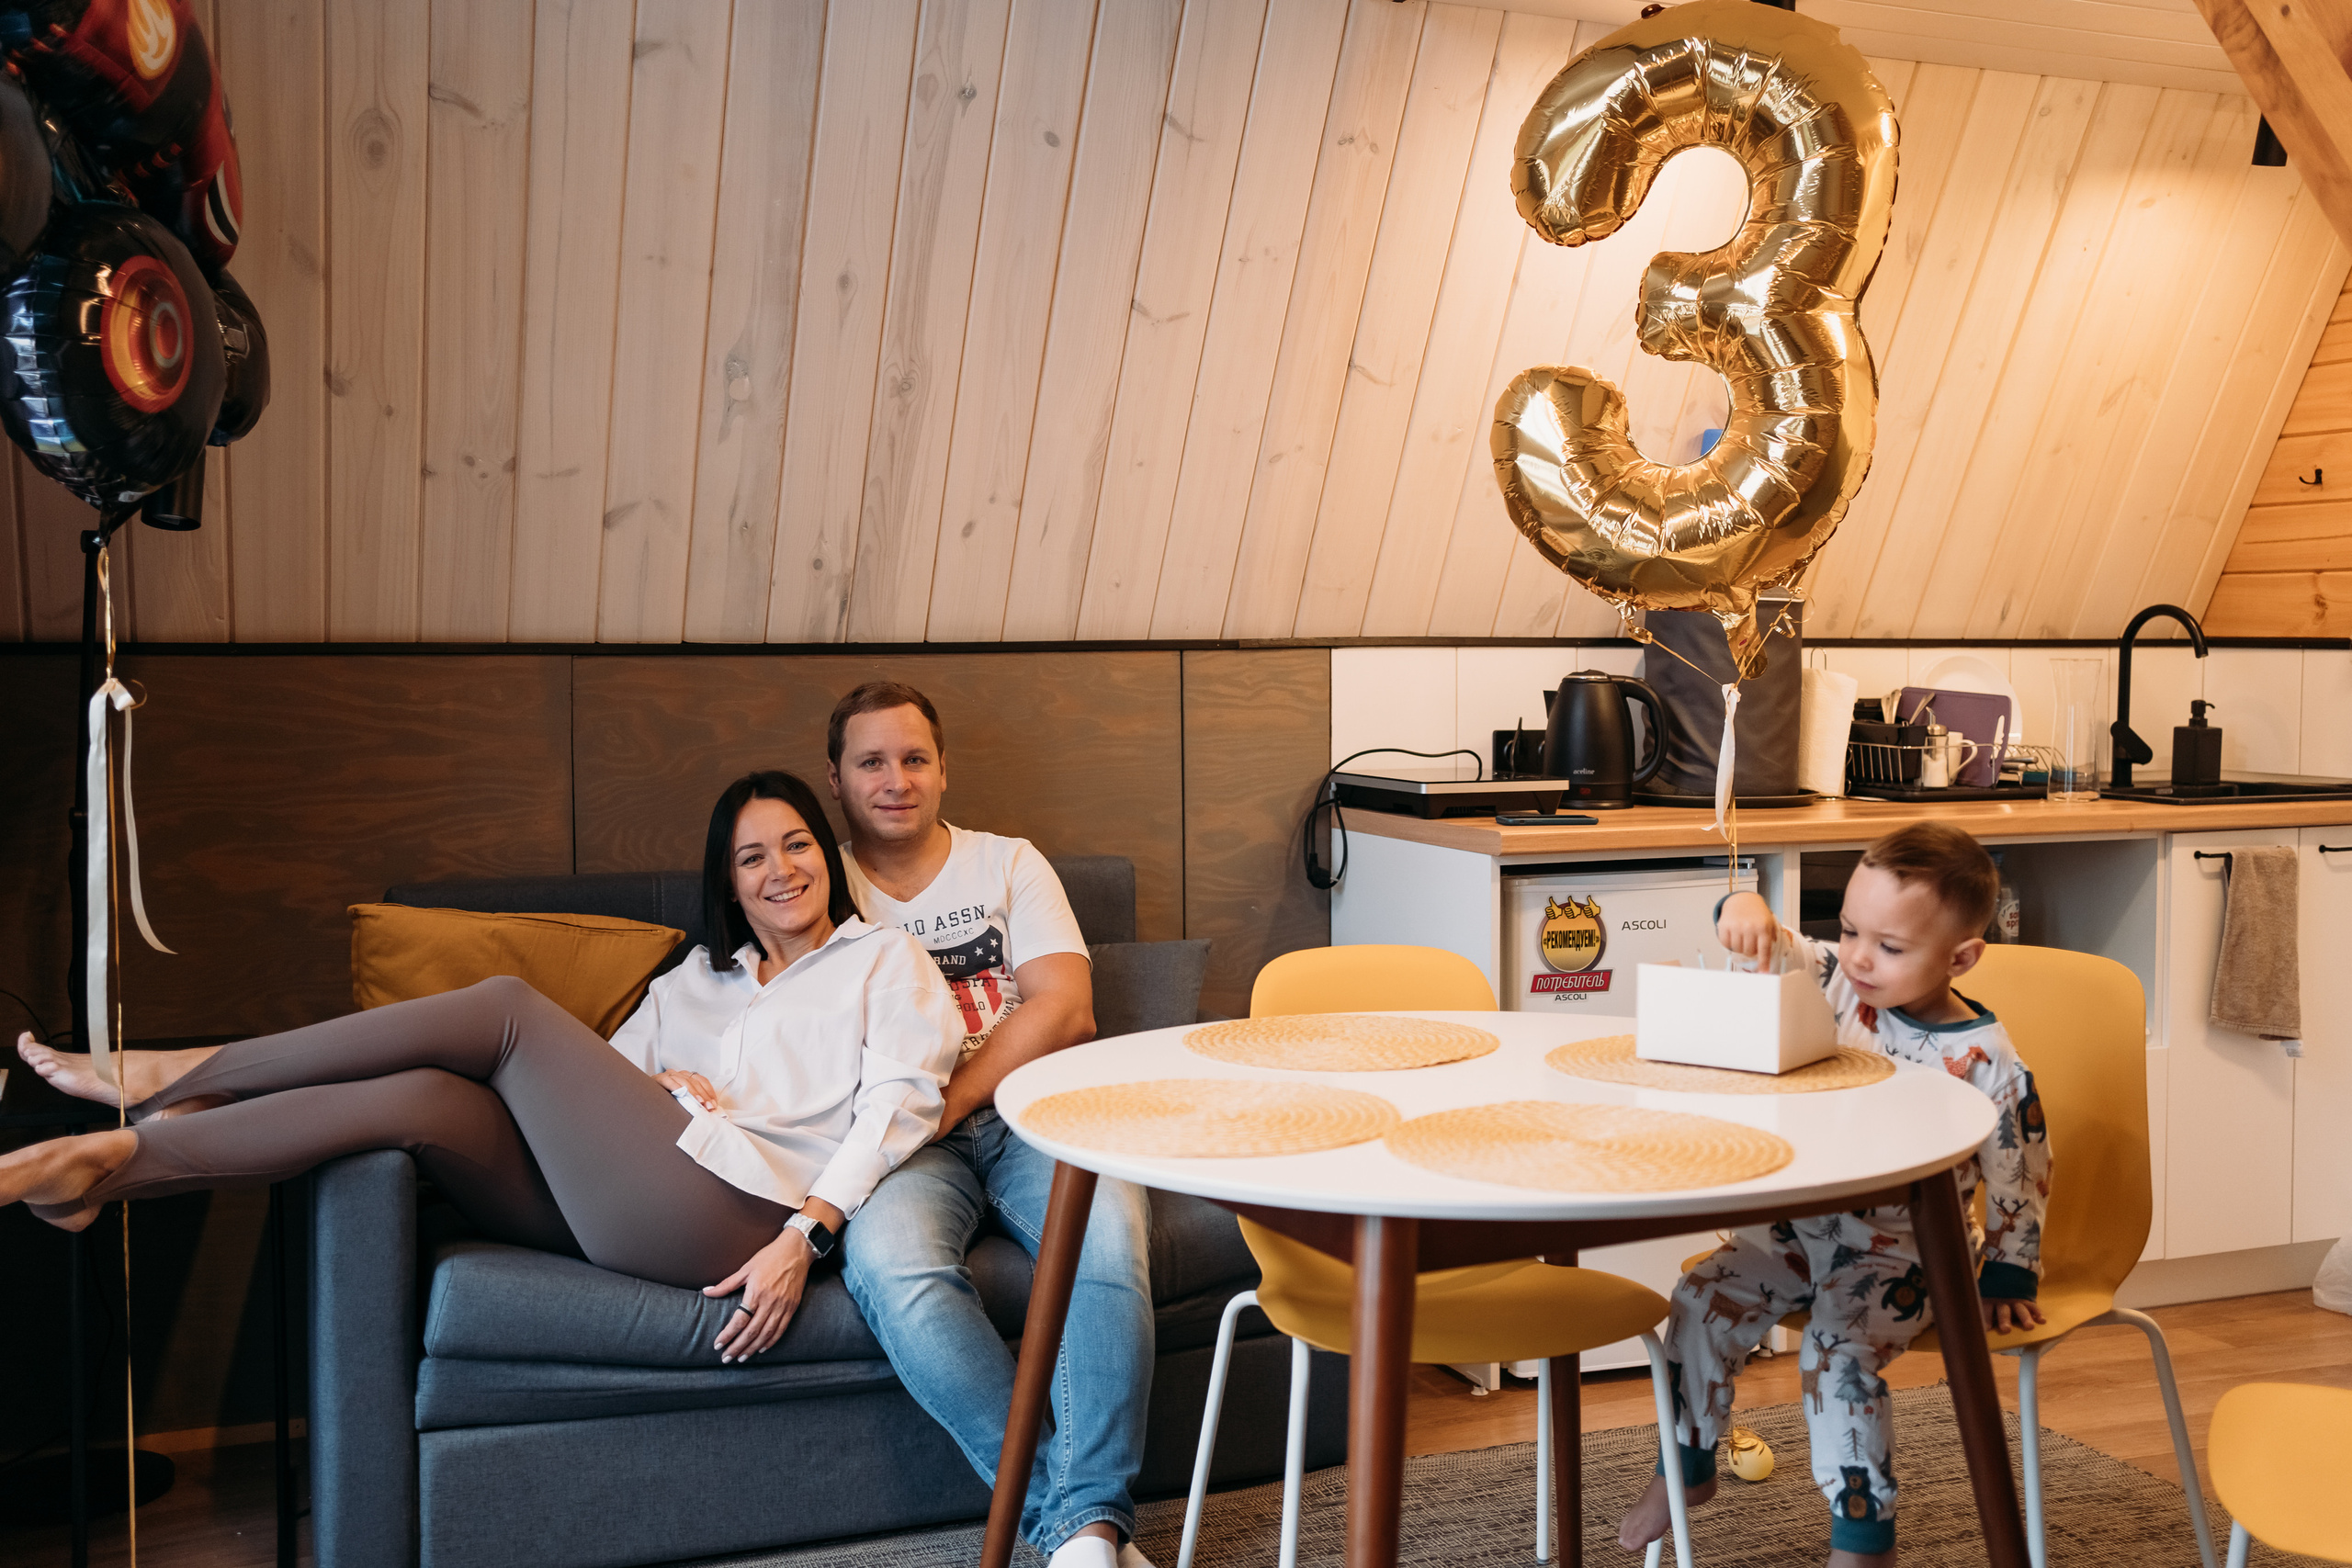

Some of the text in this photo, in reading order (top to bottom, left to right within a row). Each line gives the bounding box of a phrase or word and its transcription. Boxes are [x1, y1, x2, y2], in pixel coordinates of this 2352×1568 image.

[1490, 0, 1900, 614] 3
[1573, 767, 1595, 775] aceline
[934, 905, 990, 931] ASSN.
[1622, 919, 1667, 931] ASCOLI
[933, 927, 975, 944] MDCCCXC
[1535, 972, 1605, 991] ПОТРЕБИТЕЛЬ
[1555, 993, 1587, 1001] ASCOLI
[956, 1001, 986, 1013] POLO
